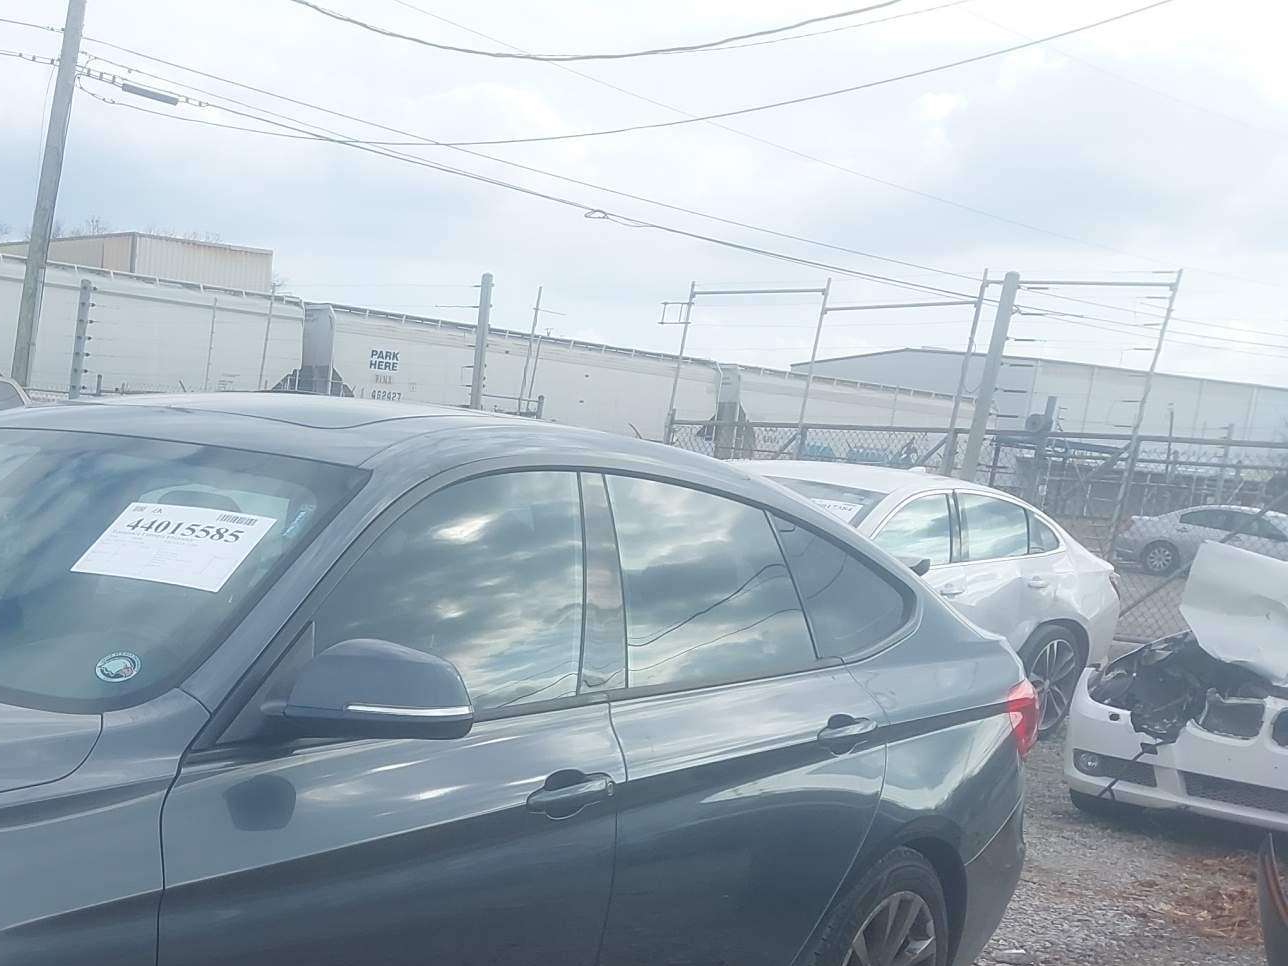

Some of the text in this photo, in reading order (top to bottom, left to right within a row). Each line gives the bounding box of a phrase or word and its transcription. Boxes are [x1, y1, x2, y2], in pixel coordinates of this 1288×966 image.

[370, 349, 401, 362] PARK
[369, 360, 400, 371] HERE
[126, 517, 245, 544] 44015585
